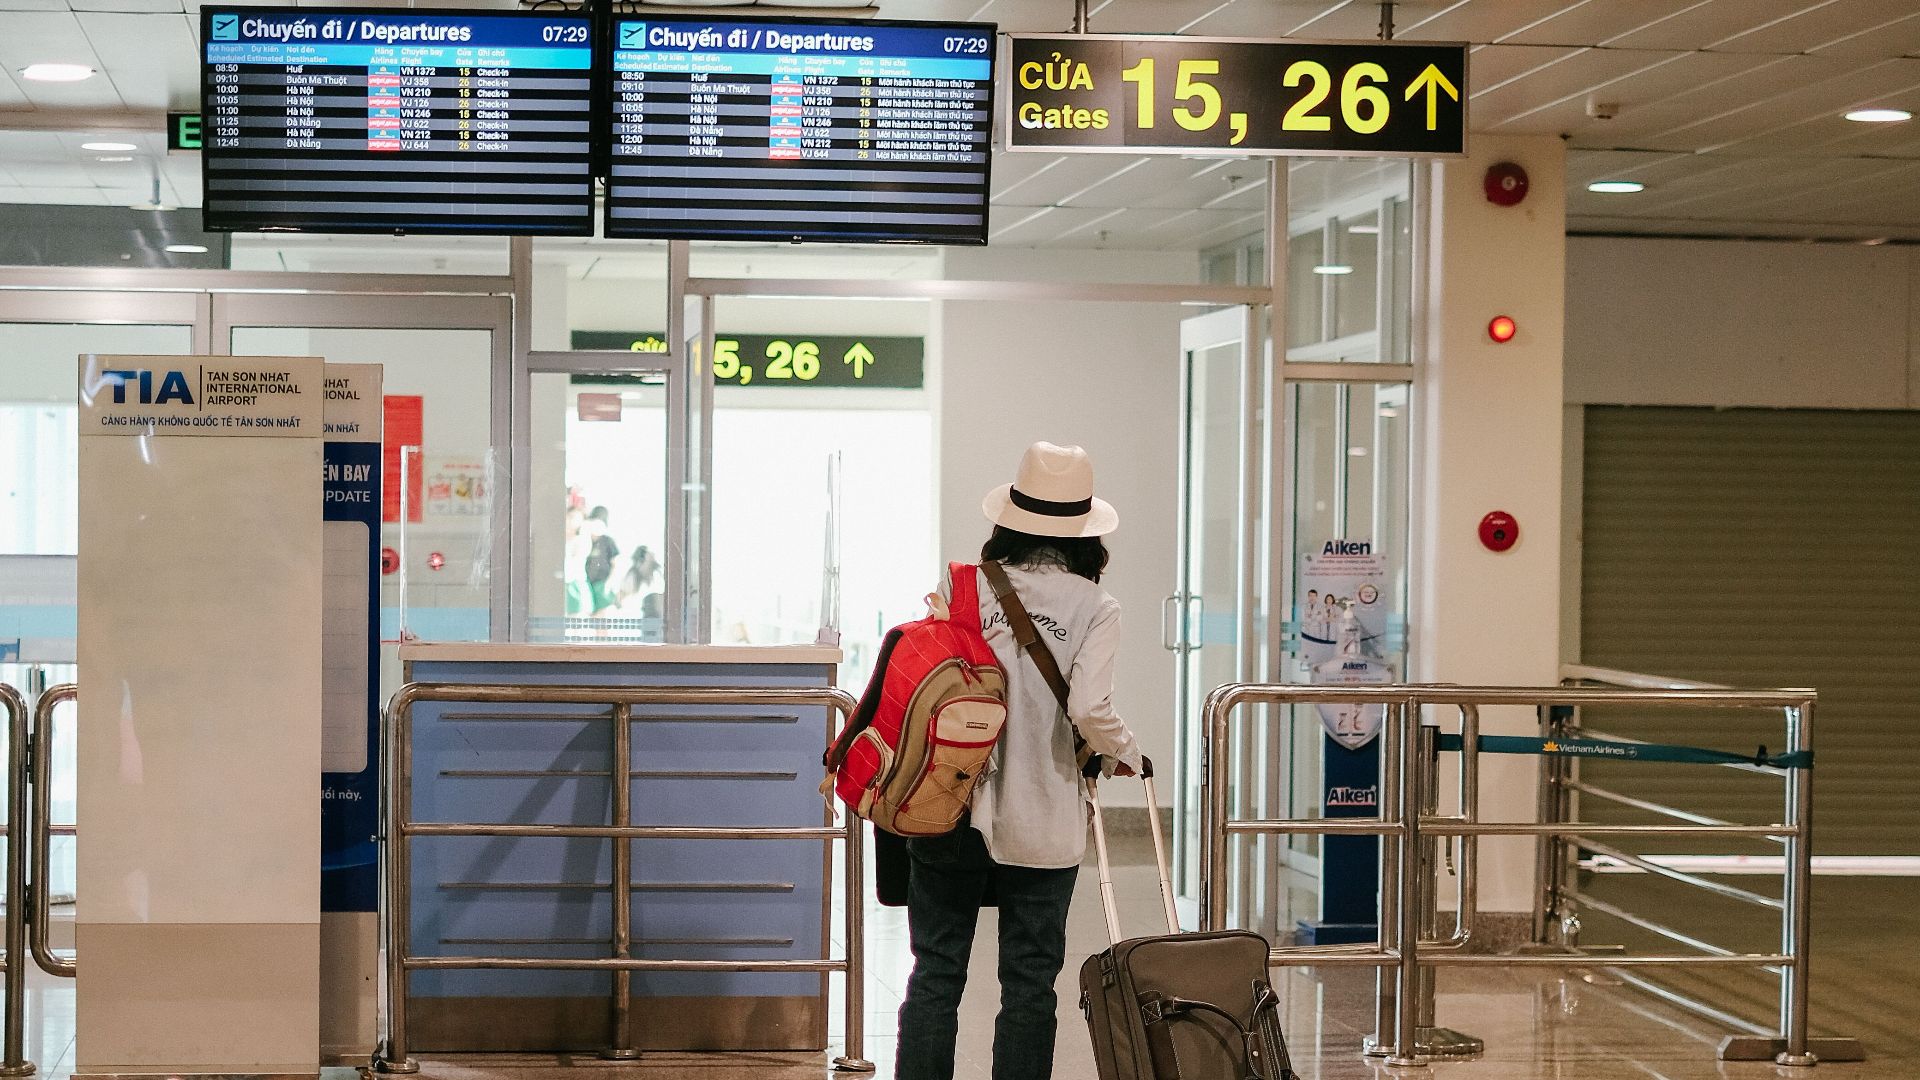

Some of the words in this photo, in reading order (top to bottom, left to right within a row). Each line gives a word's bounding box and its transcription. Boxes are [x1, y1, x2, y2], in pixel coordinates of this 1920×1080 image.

[242, 18, 317, 42] Chuyến
[322, 19, 342, 38] đi
[346, 21, 357, 40] /
[361, 21, 471, 44] Departures
[543, 26, 588, 42] 07:29
[649, 27, 722, 51] Chuyến
[728, 28, 748, 48] đi
[751, 30, 762, 50] /
[766, 30, 874, 54] Departures
[944, 37, 988, 53] 07:29
[216, 64, 238, 72] 08:50
[286, 64, 304, 73] Huế
[400, 67, 414, 76] VN
[416, 67, 436, 76] 1372
[459, 68, 470, 76] 15
[477, 68, 509, 76] Check-in
[1018, 52, 1094, 91] CỬA
[216, 75, 238, 83] 09:10
[308, 76, 322, 84] Ma
[400, 78, 412, 86] VJ
[414, 78, 429, 86] 358
[459, 78, 470, 86] 26
[477, 78, 509, 87] Check-in
[622, 72, 644, 80] 08:50
[804, 76, 817, 84] VN
[818, 76, 838, 85] 1372
[860, 78, 872, 86] 15
[216, 86, 238, 94] 10:00
[286, 86, 298, 94] Hà
[400, 88, 414, 96] VN
[414, 88, 431, 96] 210
[459, 89, 470, 98] 15
[477, 89, 509, 98] Check-in
[622, 82, 644, 90] 09:10
[804, 86, 815, 94] VJ
[860, 88, 871, 96] 26
[216, 96, 238, 104] 10:05
[286, 97, 298, 105] Hà
[400, 99, 412, 107] VJ
[414, 99, 429, 107] 126
[459, 100, 470, 108] 26
[477, 100, 509, 108] Check-in
[622, 93, 644, 102] 10:00
[803, 97, 816, 106] VN
[816, 98, 832, 106] 210
[860, 98, 871, 107] 15
[1122, 58, 1248, 146] 15,
[1281, 60, 1390, 134] 26
[216, 107, 238, 115] 11:00
[286, 108, 298, 116] Hà
[400, 109, 414, 118] VN
[415, 109, 430, 118] 246
[459, 110, 470, 118] 15
[477, 110, 509, 119] Check-in
[622, 104, 644, 112] 10:05
[802, 107, 814, 115] VJ
[816, 107, 830, 116] 126
[860, 109, 870, 117] 26
[1018, 102, 1109, 130] Gates
[216, 117, 238, 126] 11:25
[286, 118, 298, 126] Đà
[400, 120, 412, 128] VJ
[414, 120, 429, 128] 622
[459, 120, 470, 129] 26
[477, 120, 509, 130] Check-in
[620, 114, 644, 122] 11:00
[802, 118, 816, 126] VN
[816, 118, 832, 127] 246
[859, 120, 870, 128] 15
[180, 116, 202, 148] E
[216, 128, 238, 136] 12:00
[286, 129, 298, 137] Hà
[400, 130, 414, 139] VN
[415, 130, 430, 139] 212
[459, 131, 470, 140] 15
[477, 131, 509, 140] Check-in
[620, 124, 643, 133] 11:25
[802, 128, 814, 136] VJ
[814, 128, 830, 137] 622
[859, 130, 870, 138] 26
[216, 139, 238, 147] 12:45
[286, 140, 298, 148] Đà
[400, 141, 412, 150] VJ
[414, 141, 429, 150] 644
[459, 142, 470, 150] 26
[477, 142, 509, 150] Check-in
[620, 135, 643, 144] 12:00
[802, 138, 814, 148] VN
[815, 139, 831, 148] 212
[858, 140, 870, 149] 15
[620, 145, 642, 154] 12:45
[800, 148, 812, 157] VJ
[813, 149, 829, 158] 644
[858, 151, 868, 159] 26
[765, 340, 820, 381] 26
[208, 372, 229, 382] TAN
[232, 372, 258, 382] SON
[260, 372, 290, 383] NHAT
[102, 371, 194, 404] TIA
[206, 384, 301, 394] INTERNATIONAL
[208, 396, 258, 406] AIRPORT
[325, 390, 360, 400] IONAL
[130, 414, 156, 426] HÀNG
[158, 415, 190, 426] KHÔNG
[193, 414, 218, 426] QUỐC
[236, 416, 252, 427] TÂN
[276, 416, 300, 428] NHẤT
[324, 424, 334, 432] ƠN
[324, 458, 338, 481] ẾN
[344, 464, 370, 482] BAY
[326, 490, 370, 502] PDATE
[1323, 540, 1370, 556] Aiken
[1342, 662, 1368, 670] Aiken
[1560, 744, 1594, 752] Vietnam
[1594, 746, 1624, 754] Airlines
[1328, 788, 1376, 804] Aiken
